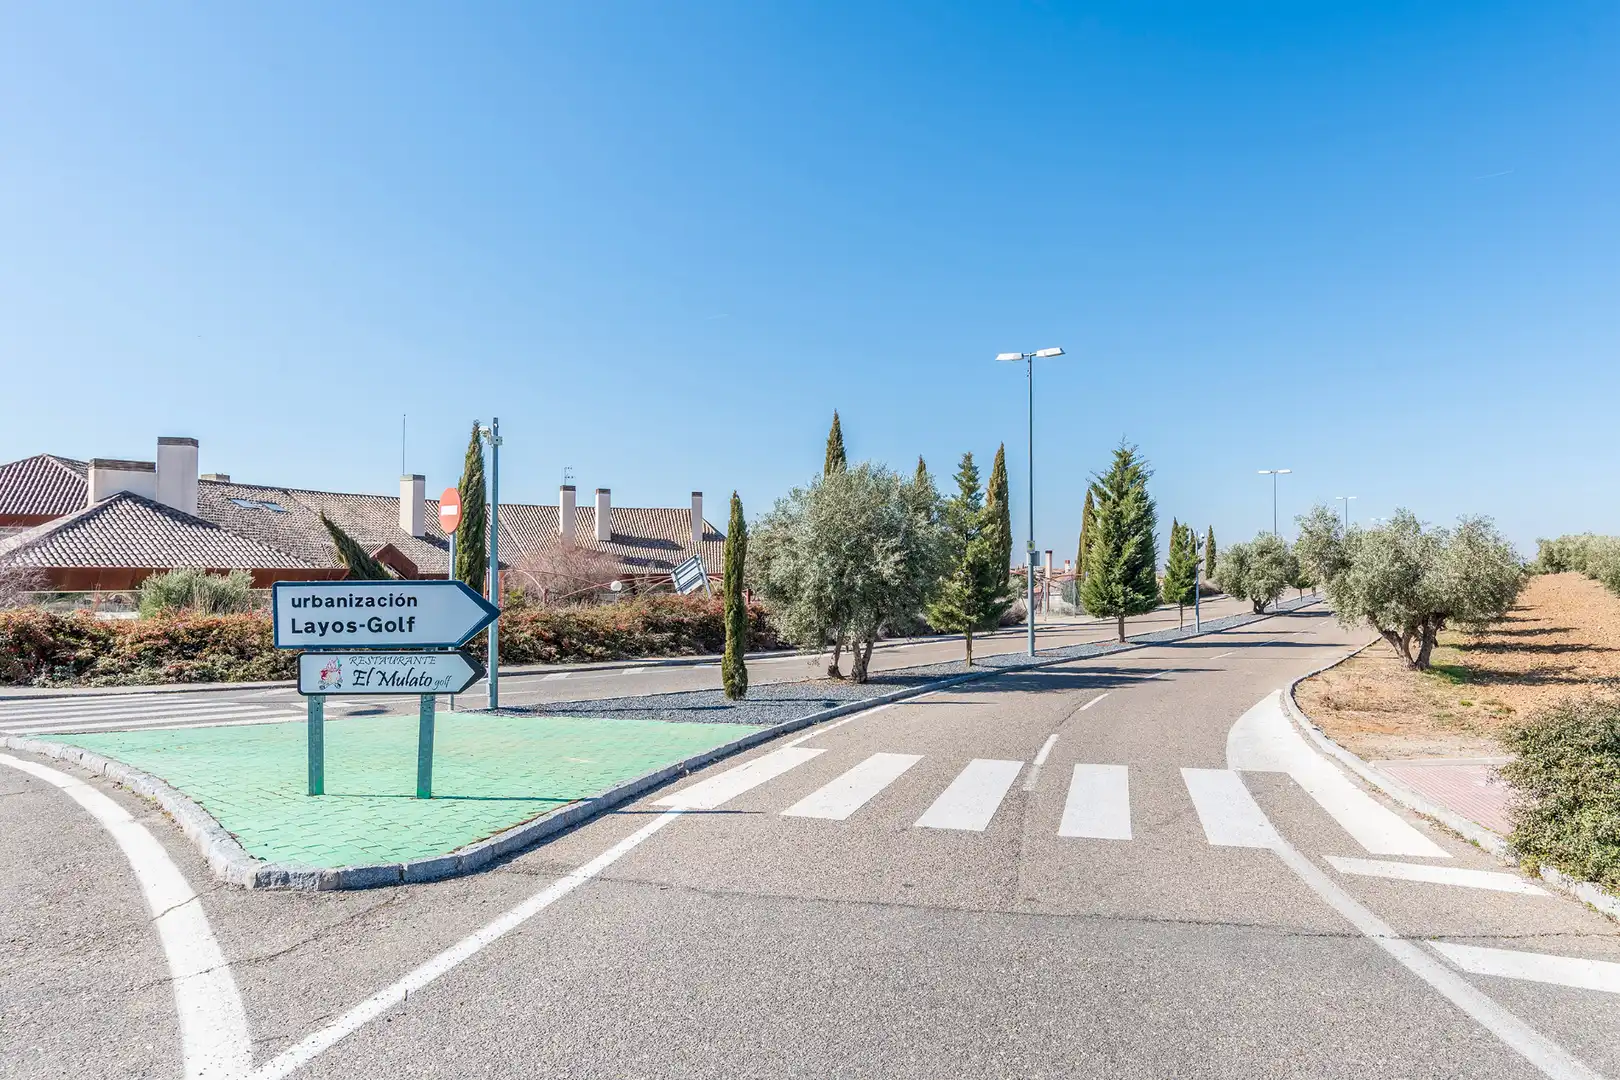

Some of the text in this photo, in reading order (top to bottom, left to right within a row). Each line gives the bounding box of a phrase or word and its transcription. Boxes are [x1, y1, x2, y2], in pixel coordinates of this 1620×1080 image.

[291, 593, 418, 608] urbanización
[291, 616, 416, 637] Layos-Golf
[349, 655, 437, 666] RESTAURANTE
[352, 667, 452, 690] El Mulato golf
